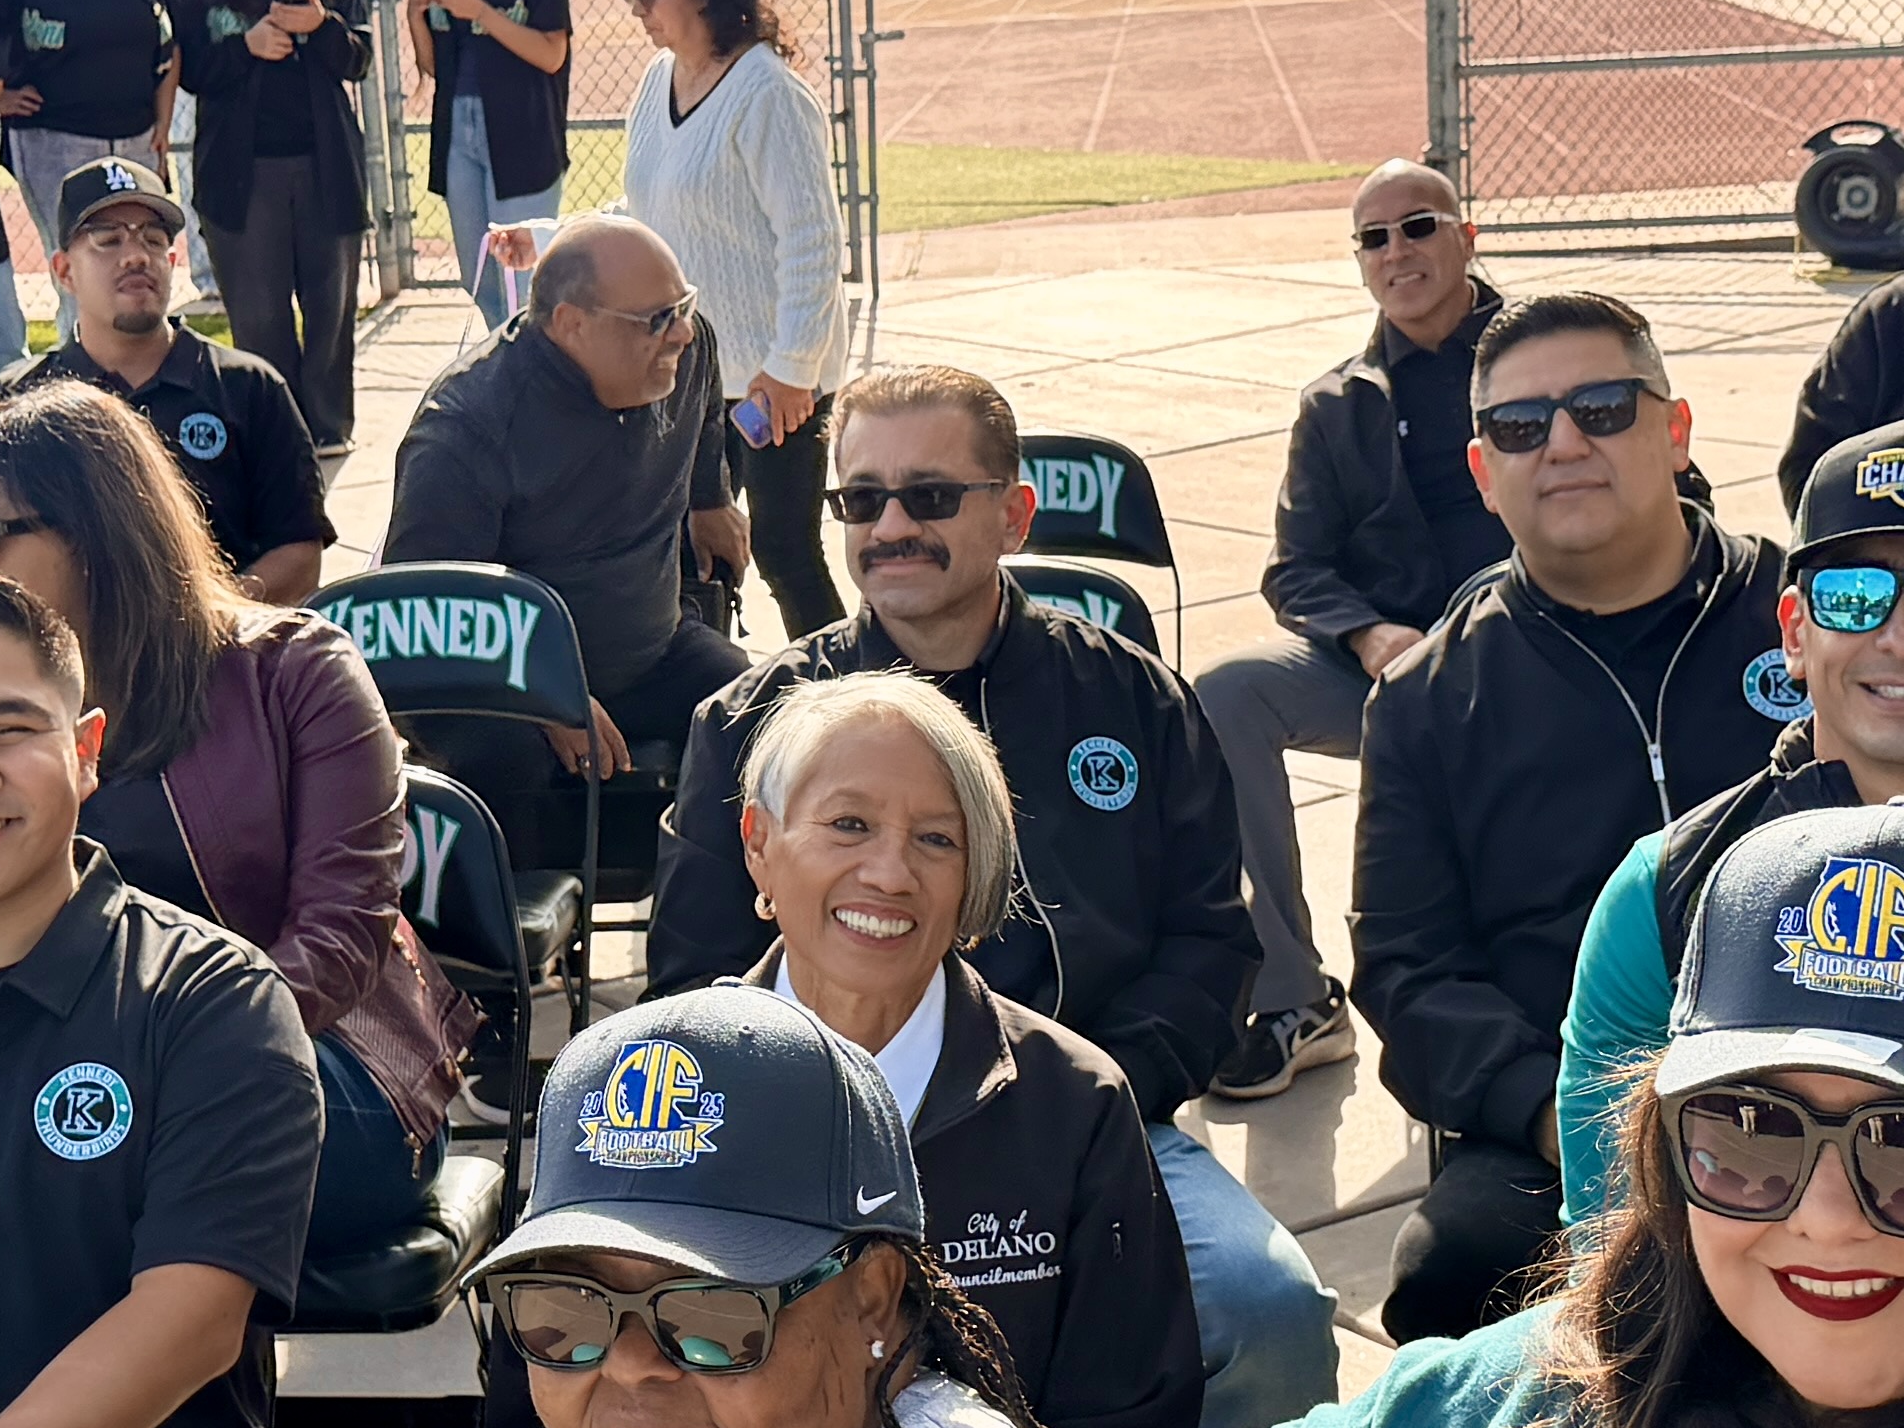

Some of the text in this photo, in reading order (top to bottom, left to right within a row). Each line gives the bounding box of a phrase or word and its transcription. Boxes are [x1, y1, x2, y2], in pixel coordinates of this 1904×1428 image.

[1087, 756, 1119, 791] K
[1776, 906, 1805, 933] 20
[58, 1065, 119, 1088] KENNEDY
[607, 1044, 698, 1129] CIF
[61, 1088, 105, 1135] K
[599, 1129, 692, 1157] FOOTBALL
[967, 1209, 1028, 1243] City of
[941, 1231, 1057, 1263] DELANO
